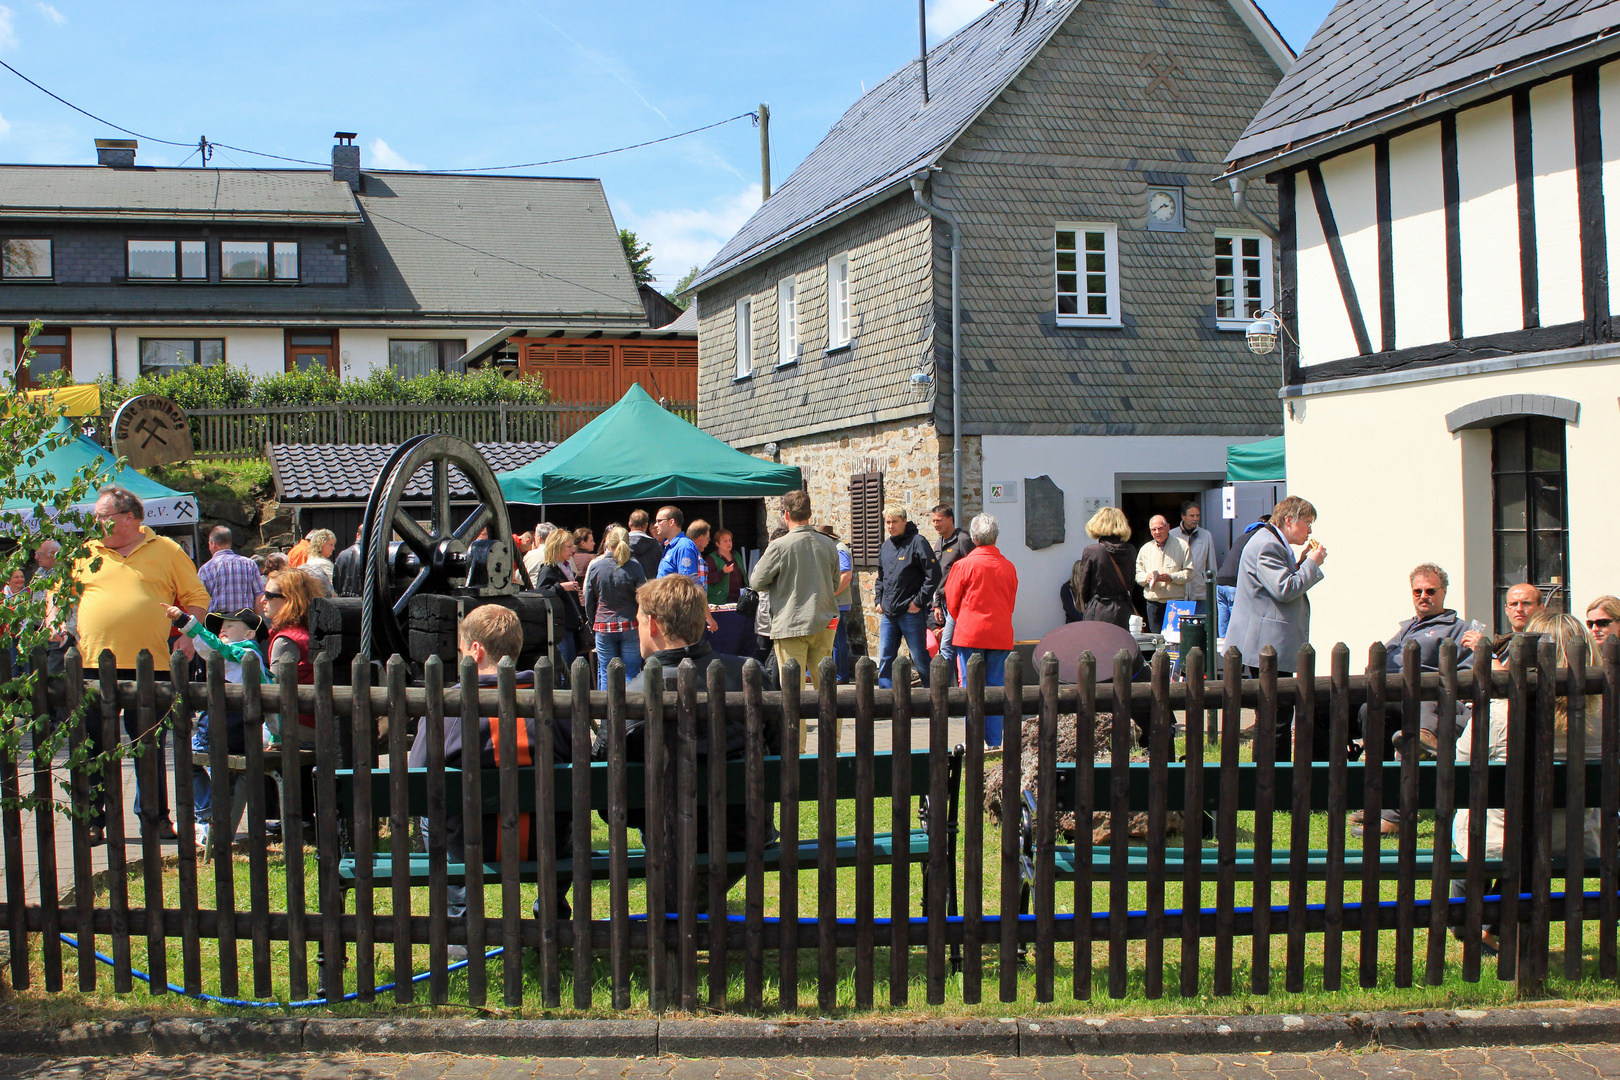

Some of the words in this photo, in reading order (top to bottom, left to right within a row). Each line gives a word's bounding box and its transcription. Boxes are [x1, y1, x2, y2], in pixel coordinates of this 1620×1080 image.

[117, 407, 138, 440] Grube
[138, 399, 184, 431] Stahlberg
[147, 506, 169, 518] e.V.
